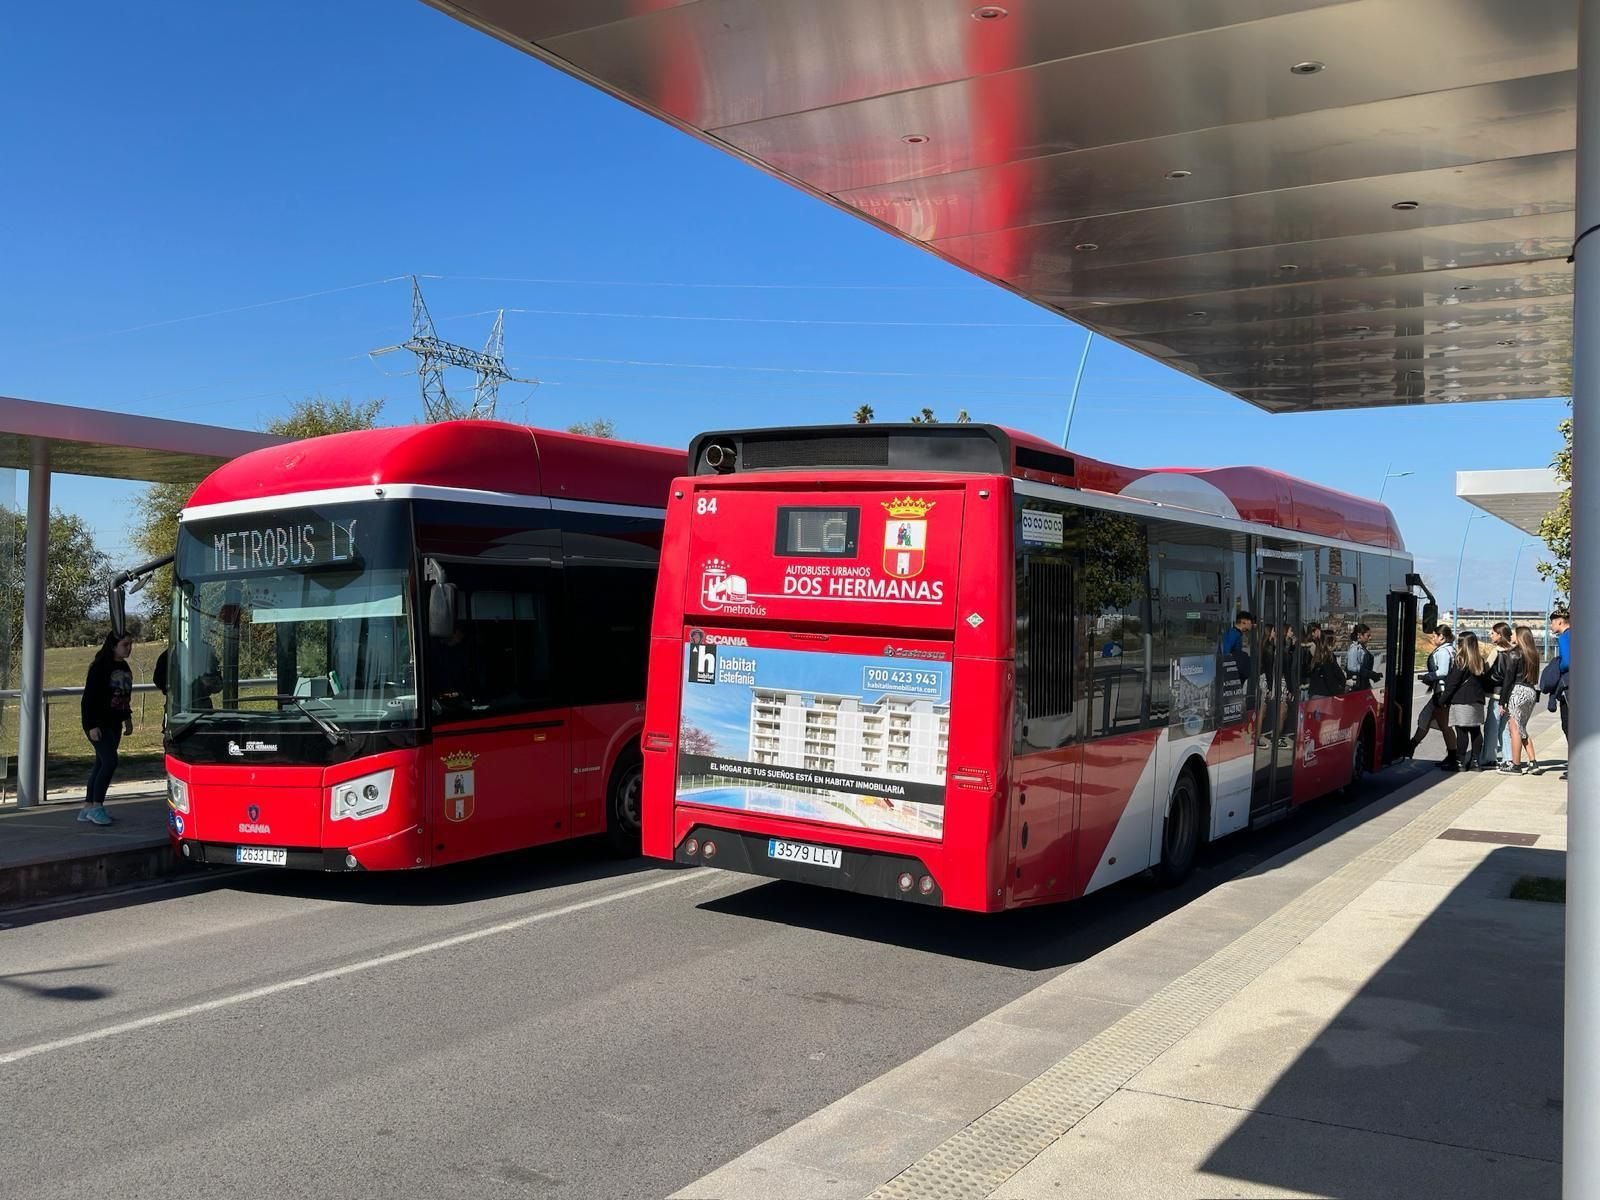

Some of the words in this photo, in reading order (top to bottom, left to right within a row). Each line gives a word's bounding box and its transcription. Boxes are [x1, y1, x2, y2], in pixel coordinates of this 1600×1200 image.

[696, 497, 717, 515] 84
[797, 517, 847, 553] L6
[214, 524, 315, 571] METROBUS
[785, 564, 830, 577] AUTOBUSES
[832, 566, 871, 578] URBANOS
[783, 576, 823, 595] DOS
[829, 578, 944, 600] HERMANAS
[723, 604, 767, 617] metrobús
[705, 634, 748, 647] SCANIA
[719, 656, 757, 673] habitat
[719, 670, 755, 685] Estefanía
[868, 669, 889, 681] 900
[891, 671, 913, 684] 423
[915, 672, 937, 686] 943
[710, 762, 719, 771] EL
[719, 763, 742, 774] HOGAR
[743, 766, 752, 775] DE
[753, 767, 767, 777] TUS
[767, 768, 795, 781] SUEÑOS
[795, 772, 813, 783] ESTÁ
[814, 775, 824, 784] EN
[825, 776, 854, 788] HABITAT
[855, 779, 905, 795] INMOBILIARIA
[238, 823, 271, 834] SCANIA
[242, 847, 264, 861] 2633
[266, 848, 285, 863] LRP
[777, 842, 809, 861] 3579
[813, 846, 839, 865] LLV
